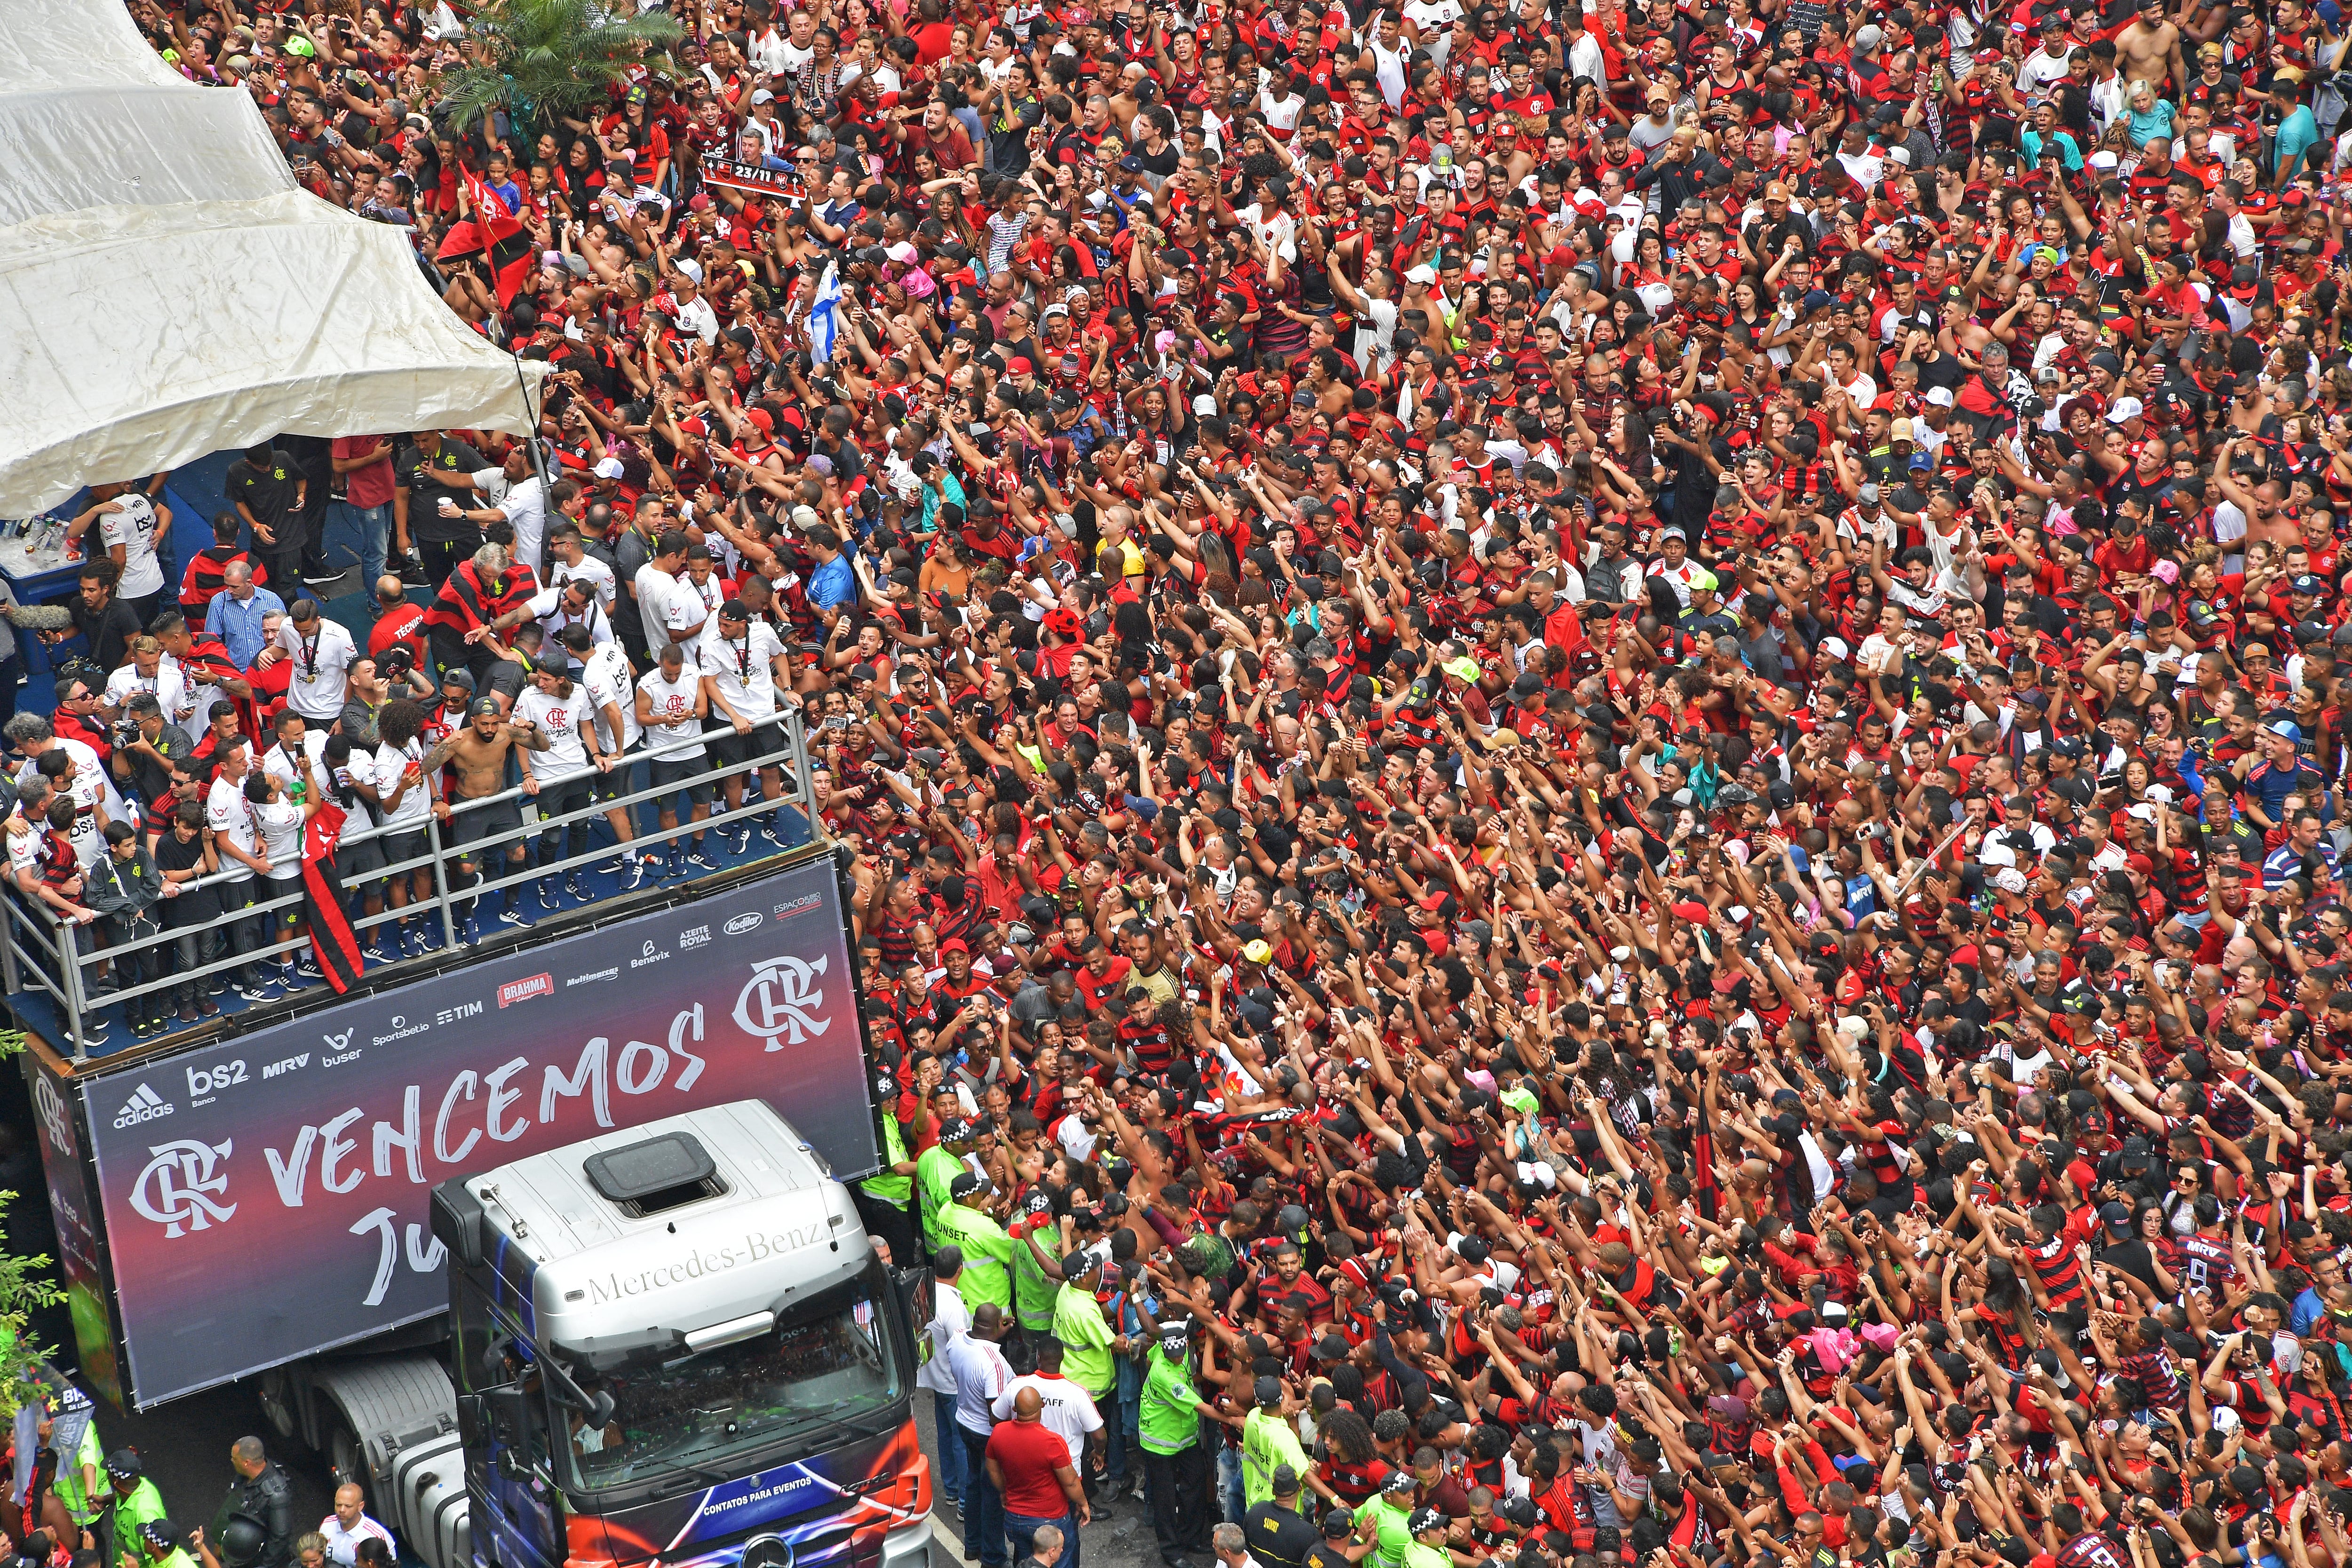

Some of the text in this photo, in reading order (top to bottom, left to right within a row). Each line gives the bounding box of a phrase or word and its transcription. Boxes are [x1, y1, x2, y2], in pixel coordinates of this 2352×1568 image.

[1476, 123, 1484, 135] 10
[735, 165, 771, 183] 23/11
[612, 663, 627, 688] bs2
[15, 856, 31, 865] buser
[1851, 884, 1872, 904] MRV
[680, 925, 708, 939] AZEITE
[728, 915, 760, 932] Kodilar
[680, 934, 712, 949] ROYAL
[631, 950, 670, 968] Benevix
[567, 967, 619, 987] Multimarcas
[503, 977, 547, 1000] BRAHMA
[453, 1001, 483, 1019] TIM
[373, 1023, 429, 1046] Sportsbet.io
[262, 1052, 310, 1079] MRV
[322, 1048, 362, 1067] buser
[185, 1059, 248, 1097] bs2
[191, 1097, 216, 1108] Banco
[264, 1002, 707, 1207] VENCEMOS
[113, 1102, 174, 1129] adidas
[2186, 1241, 2221, 1258] MRV
[588, 1223, 823, 1306] Mercedes-Benz
[1041, 1397, 1064, 1408] TAFF
[703, 1476, 813, 1515] CONTATOS PARA EVENTOS
[1263, 1517, 1279, 1534] SUNSET
[2074, 1537, 2101, 1556] MRV
